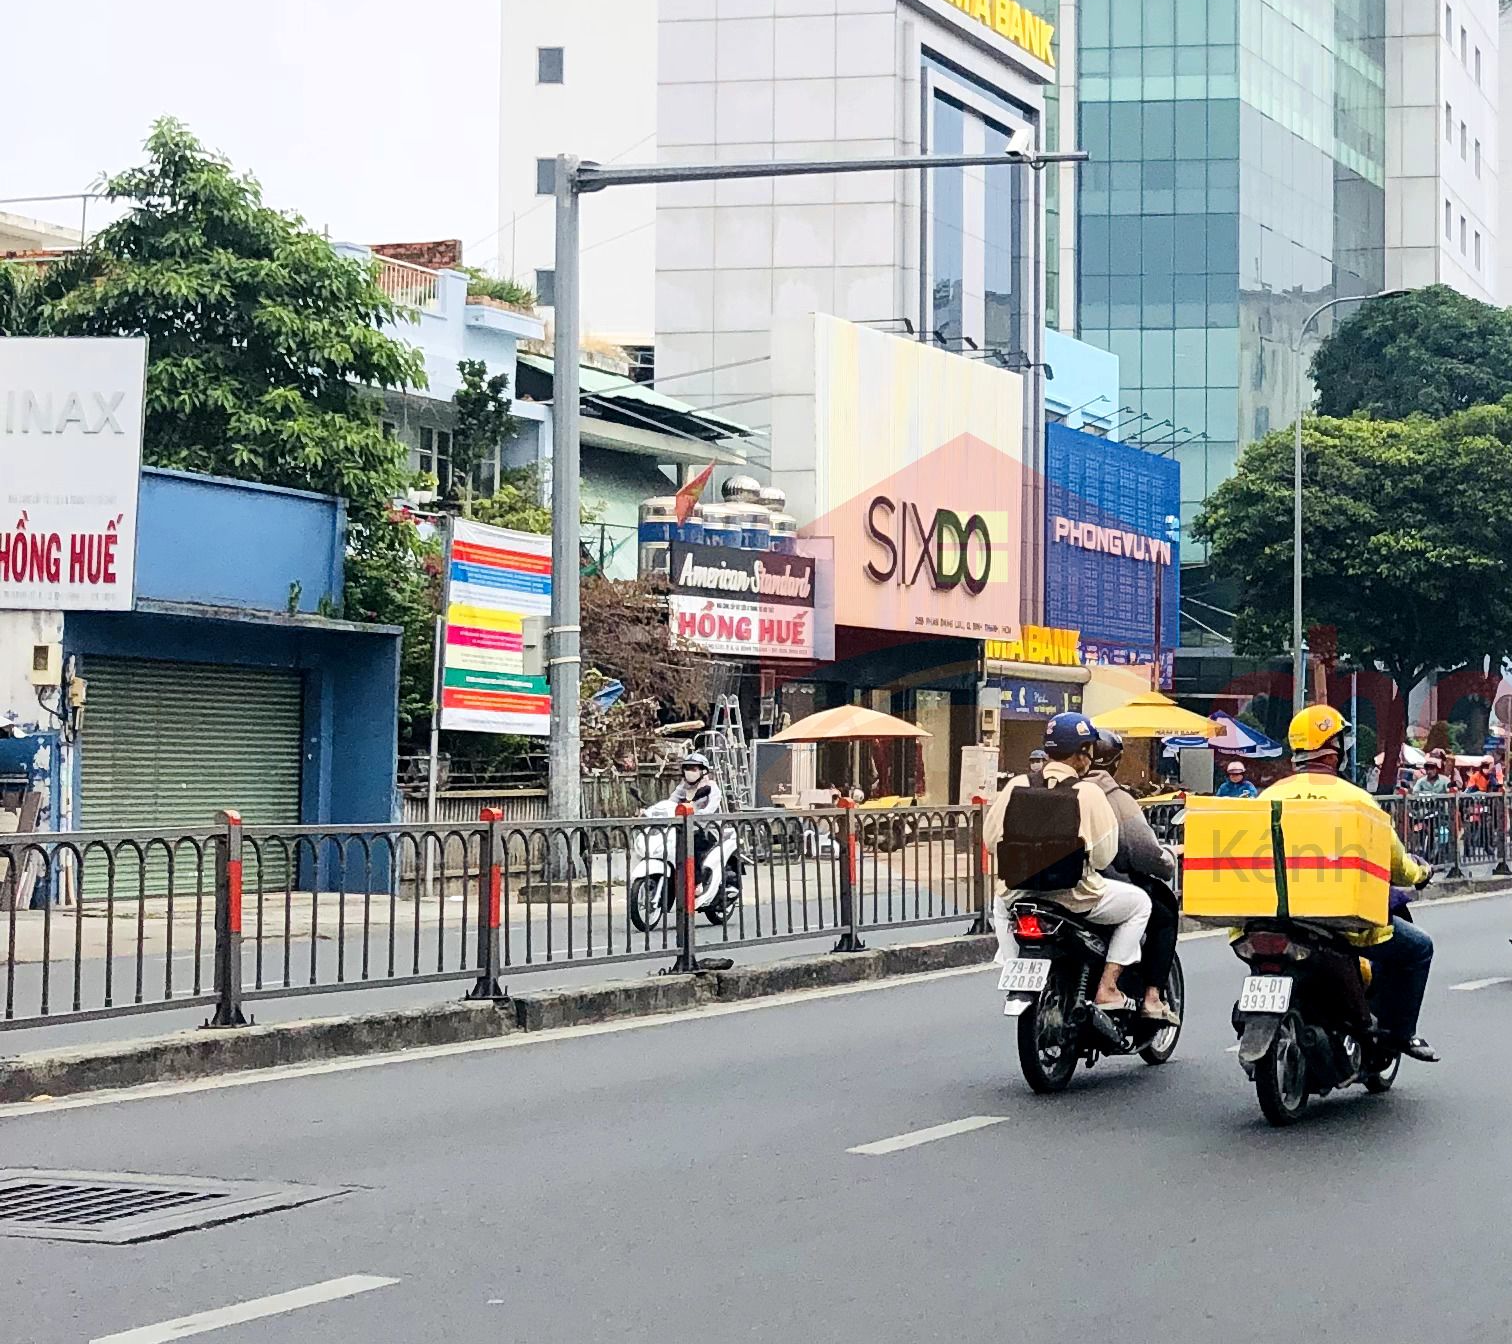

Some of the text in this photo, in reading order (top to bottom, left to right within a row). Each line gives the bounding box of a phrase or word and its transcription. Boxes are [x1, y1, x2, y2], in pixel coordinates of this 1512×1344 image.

[6, 390, 125, 434] INAX
[69, 513, 124, 585] HUẾ
[864, 495, 992, 596] SIXDO
[1053, 516, 1171, 566] PHONGVU.VN
[678, 552, 811, 599] American Standard
[1025, 624, 1081, 666] BANK
[1010, 961, 1043, 974] 79-N3
[1249, 978, 1283, 993] 64-D1
